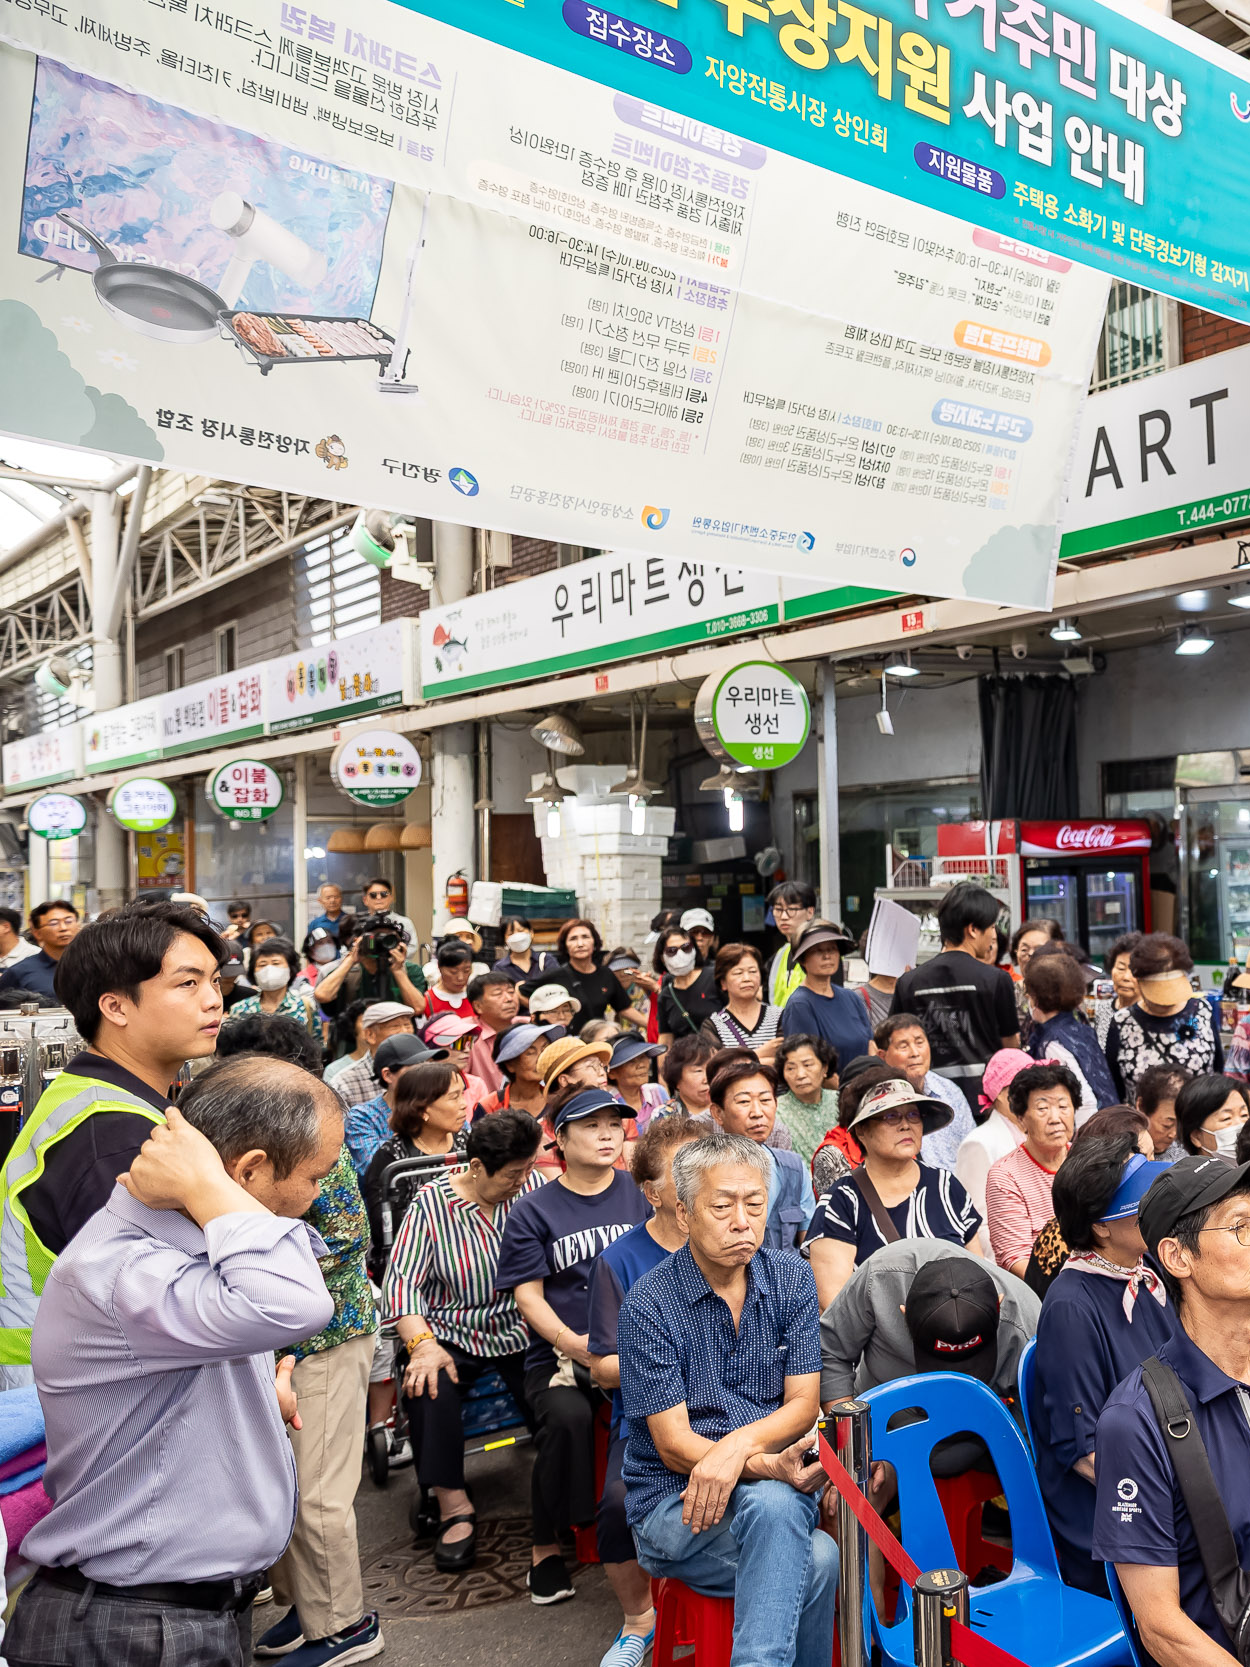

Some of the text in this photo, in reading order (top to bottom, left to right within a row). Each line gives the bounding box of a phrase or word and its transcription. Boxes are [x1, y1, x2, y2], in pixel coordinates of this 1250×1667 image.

[585, 6, 676, 66] 접수장소
[704, 55, 888, 153] 자양전통시장 상인회
[1109, 47, 1187, 137] 대상
[962, 71, 1053, 167] 사업
[1064, 116, 1145, 206] 안내
[928, 147, 993, 195] 지원물품
[1013, 180, 1060, 220] 주택용
[1063, 202, 1107, 240] 소화기
[1112, 222, 1126, 246] 및
[1130, 227, 1207, 276] 단독경보기형
[1211, 261, 1249, 292] 감지기
[725, 686, 796, 707] 우리마트
[744, 713, 780, 736] 생선
[752, 746, 775, 761] 생선
[219, 780, 230, 793] &
[233, 767, 267, 785] 이불
[234, 787, 268, 804] 잡화
[1055, 824, 1117, 850] Coca-Cola
